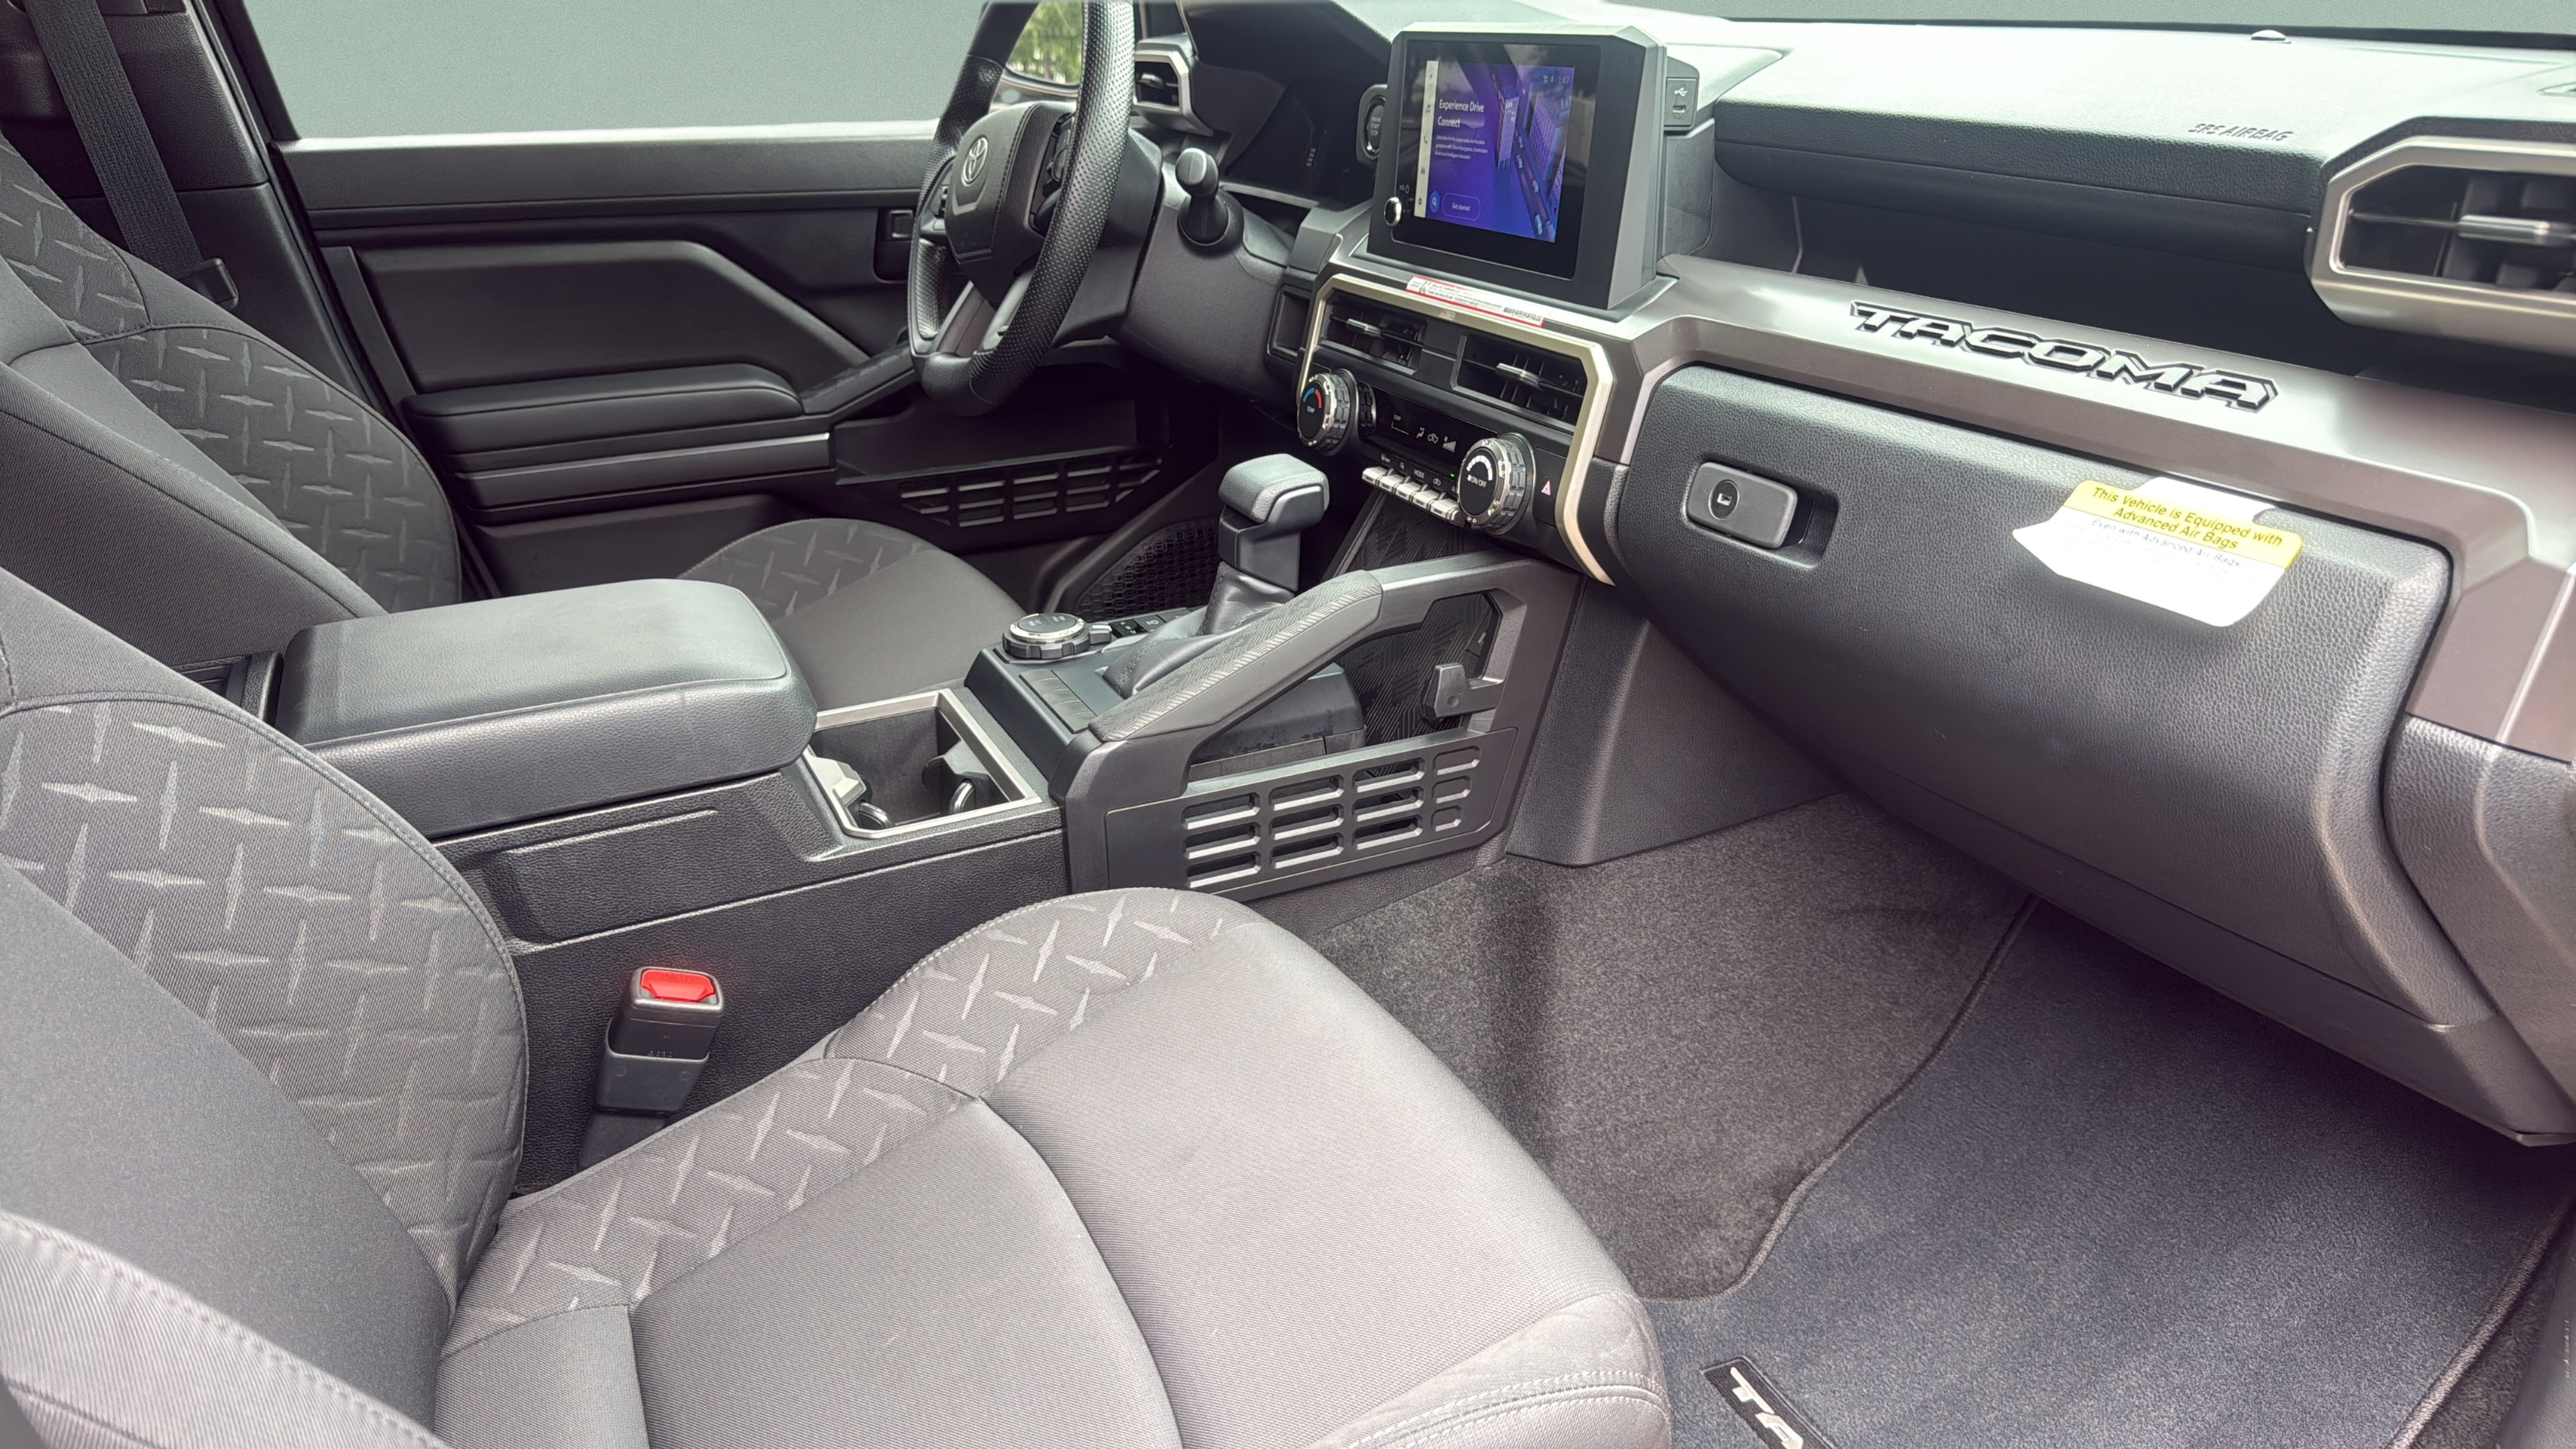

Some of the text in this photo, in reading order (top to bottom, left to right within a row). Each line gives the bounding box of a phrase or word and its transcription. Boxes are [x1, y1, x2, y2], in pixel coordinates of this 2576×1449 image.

[1439, 99, 1485, 113] Experience Drive
[1437, 115, 1461, 128] Connect
[1850, 300, 2279, 413] TACOMA
[1413, 468, 1425, 479] MODE
[1471, 474, 1488, 488] ON/OFF
[2092, 486, 2283, 546] This Vehicle is Equipped with
[2113, 507, 2239, 549] Advanced Air Bags
[2091, 518, 2116, 531] Even
[2119, 526, 2140, 537] with
[2142, 533, 2193, 553] Advanced
[2213, 552, 2241, 568] Bags
